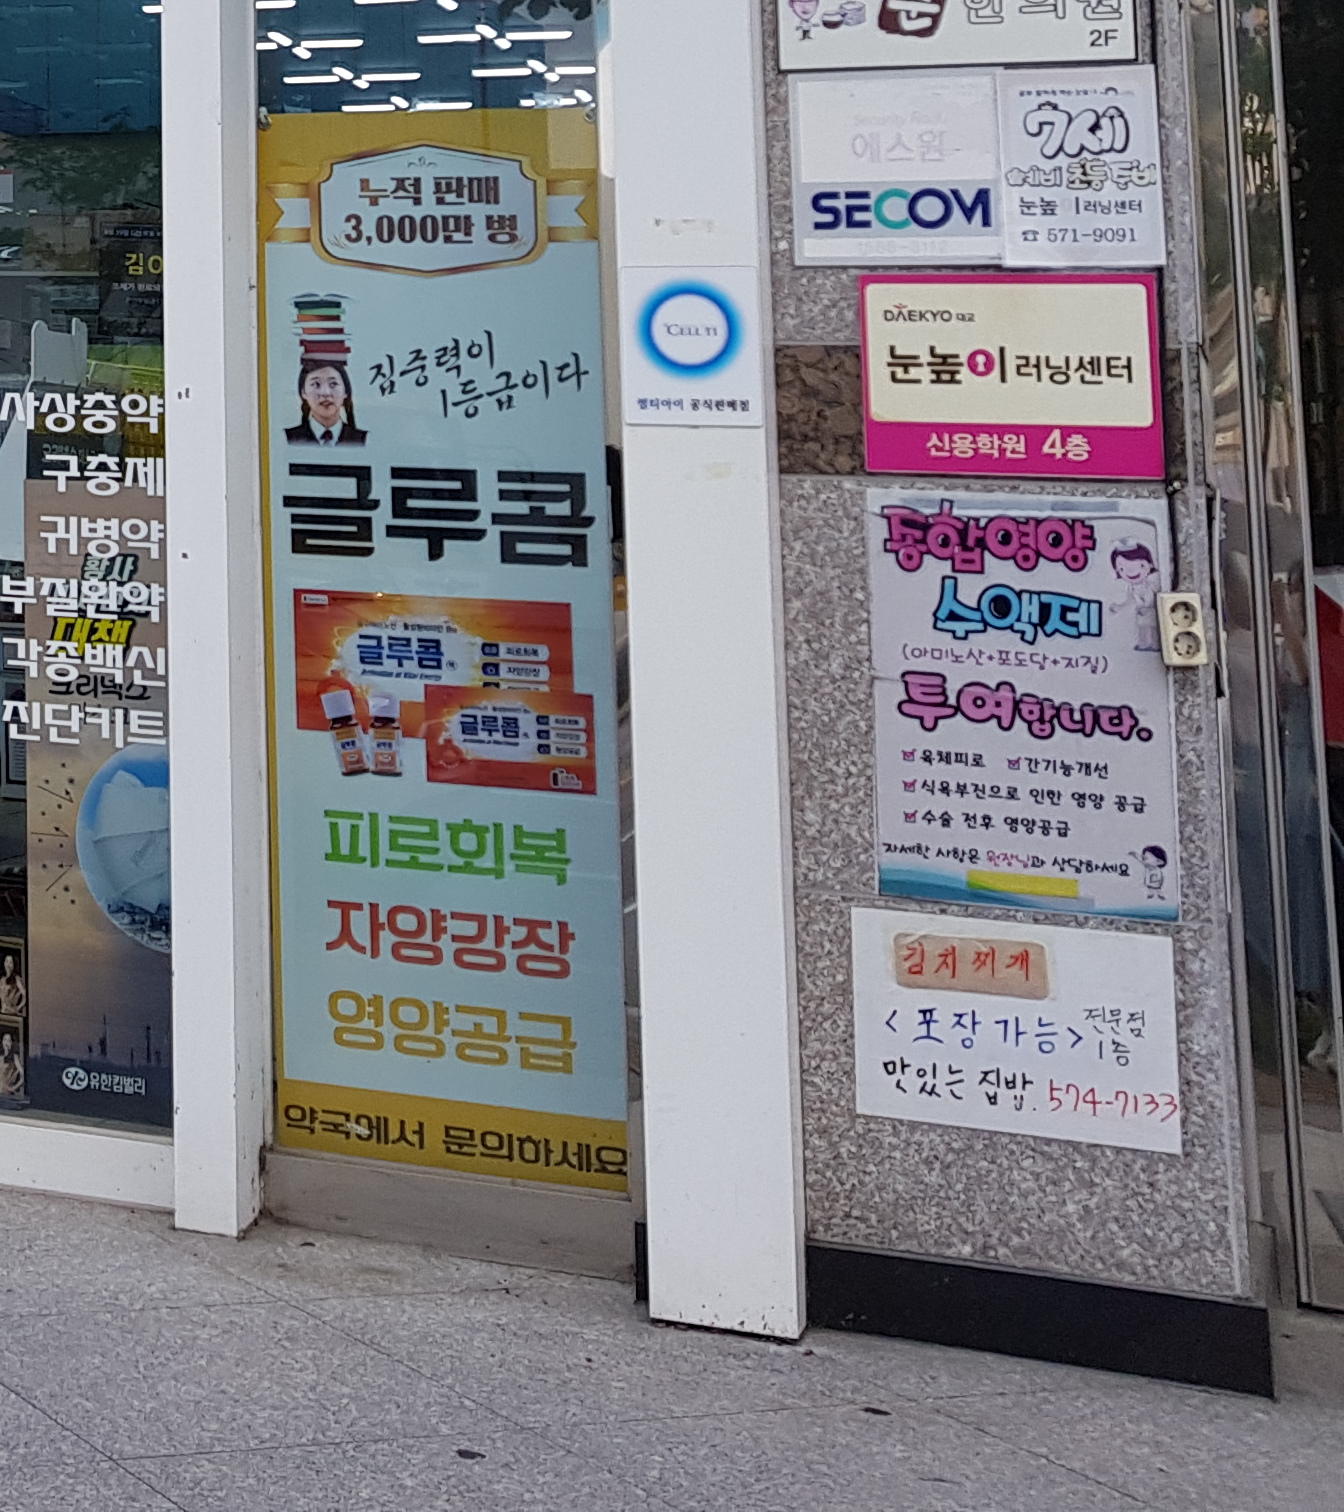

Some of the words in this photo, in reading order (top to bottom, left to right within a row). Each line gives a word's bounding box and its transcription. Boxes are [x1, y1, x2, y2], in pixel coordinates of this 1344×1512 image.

[1089, 28, 1119, 48] 2F
[358, 176, 423, 207] 누적
[431, 175, 500, 207] 판매
[1066, 157, 1109, 192] 초등
[811, 187, 993, 231] SECOM
[1083, 199, 1143, 215] 러닝센터
[344, 213, 475, 245] 3,000만
[484, 213, 520, 246] 병
[1047, 227, 1137, 243] 571-9091
[883, 306, 953, 323] DAEKYO
[368, 329, 496, 397] 집중력이
[885, 344, 1006, 386] 눈높이
[1014, 353, 1134, 385] 러닝센터
[925, 432, 1028, 460] 신용학원
[1042, 428, 1092, 461] 4층
[42, 454, 165, 497] 구충제
[282, 461, 596, 568] 글루콤
[39, 514, 165, 560] 귀병약
[932, 576, 1102, 644] 수액제
[2, 637, 167, 687] 각종백신
[357, 634, 445, 671] 글루콤
[2, 700, 167, 749] 진단키트
[898, 671, 1153, 739] 투여합니다.
[459, 713, 520, 739] 글루콤
[919, 749, 987, 768] 육체피로
[1023, 756, 1110, 780] 간기능개선
[1029, 788, 1062, 807] 인한
[1070, 791, 1105, 811] 영양
[1114, 795, 1147, 814] 공급
[921, 809, 954, 826] 수술
[962, 811, 996, 831] 전후
[1003, 815, 1072, 838] 영양공급
[323, 808, 572, 885] 피로회복
[882, 842, 931, 860] 자세한
[935, 847, 982, 865] 사항은
[985, 850, 1047, 869] 원장님과
[1051, 855, 1131, 878] 상담하세요
[325, 898, 576, 980] 자양강장
[327, 989, 578, 1075] 영양공급
[89, 1071, 147, 1096] 유한킴벌리
[883, 1056, 965, 1100] 맛있는
[1048, 1079, 1179, 1123] 574-7133
[283, 1103, 427, 1150] 약국에서
[441, 1124, 629, 1177] 문의하세요
